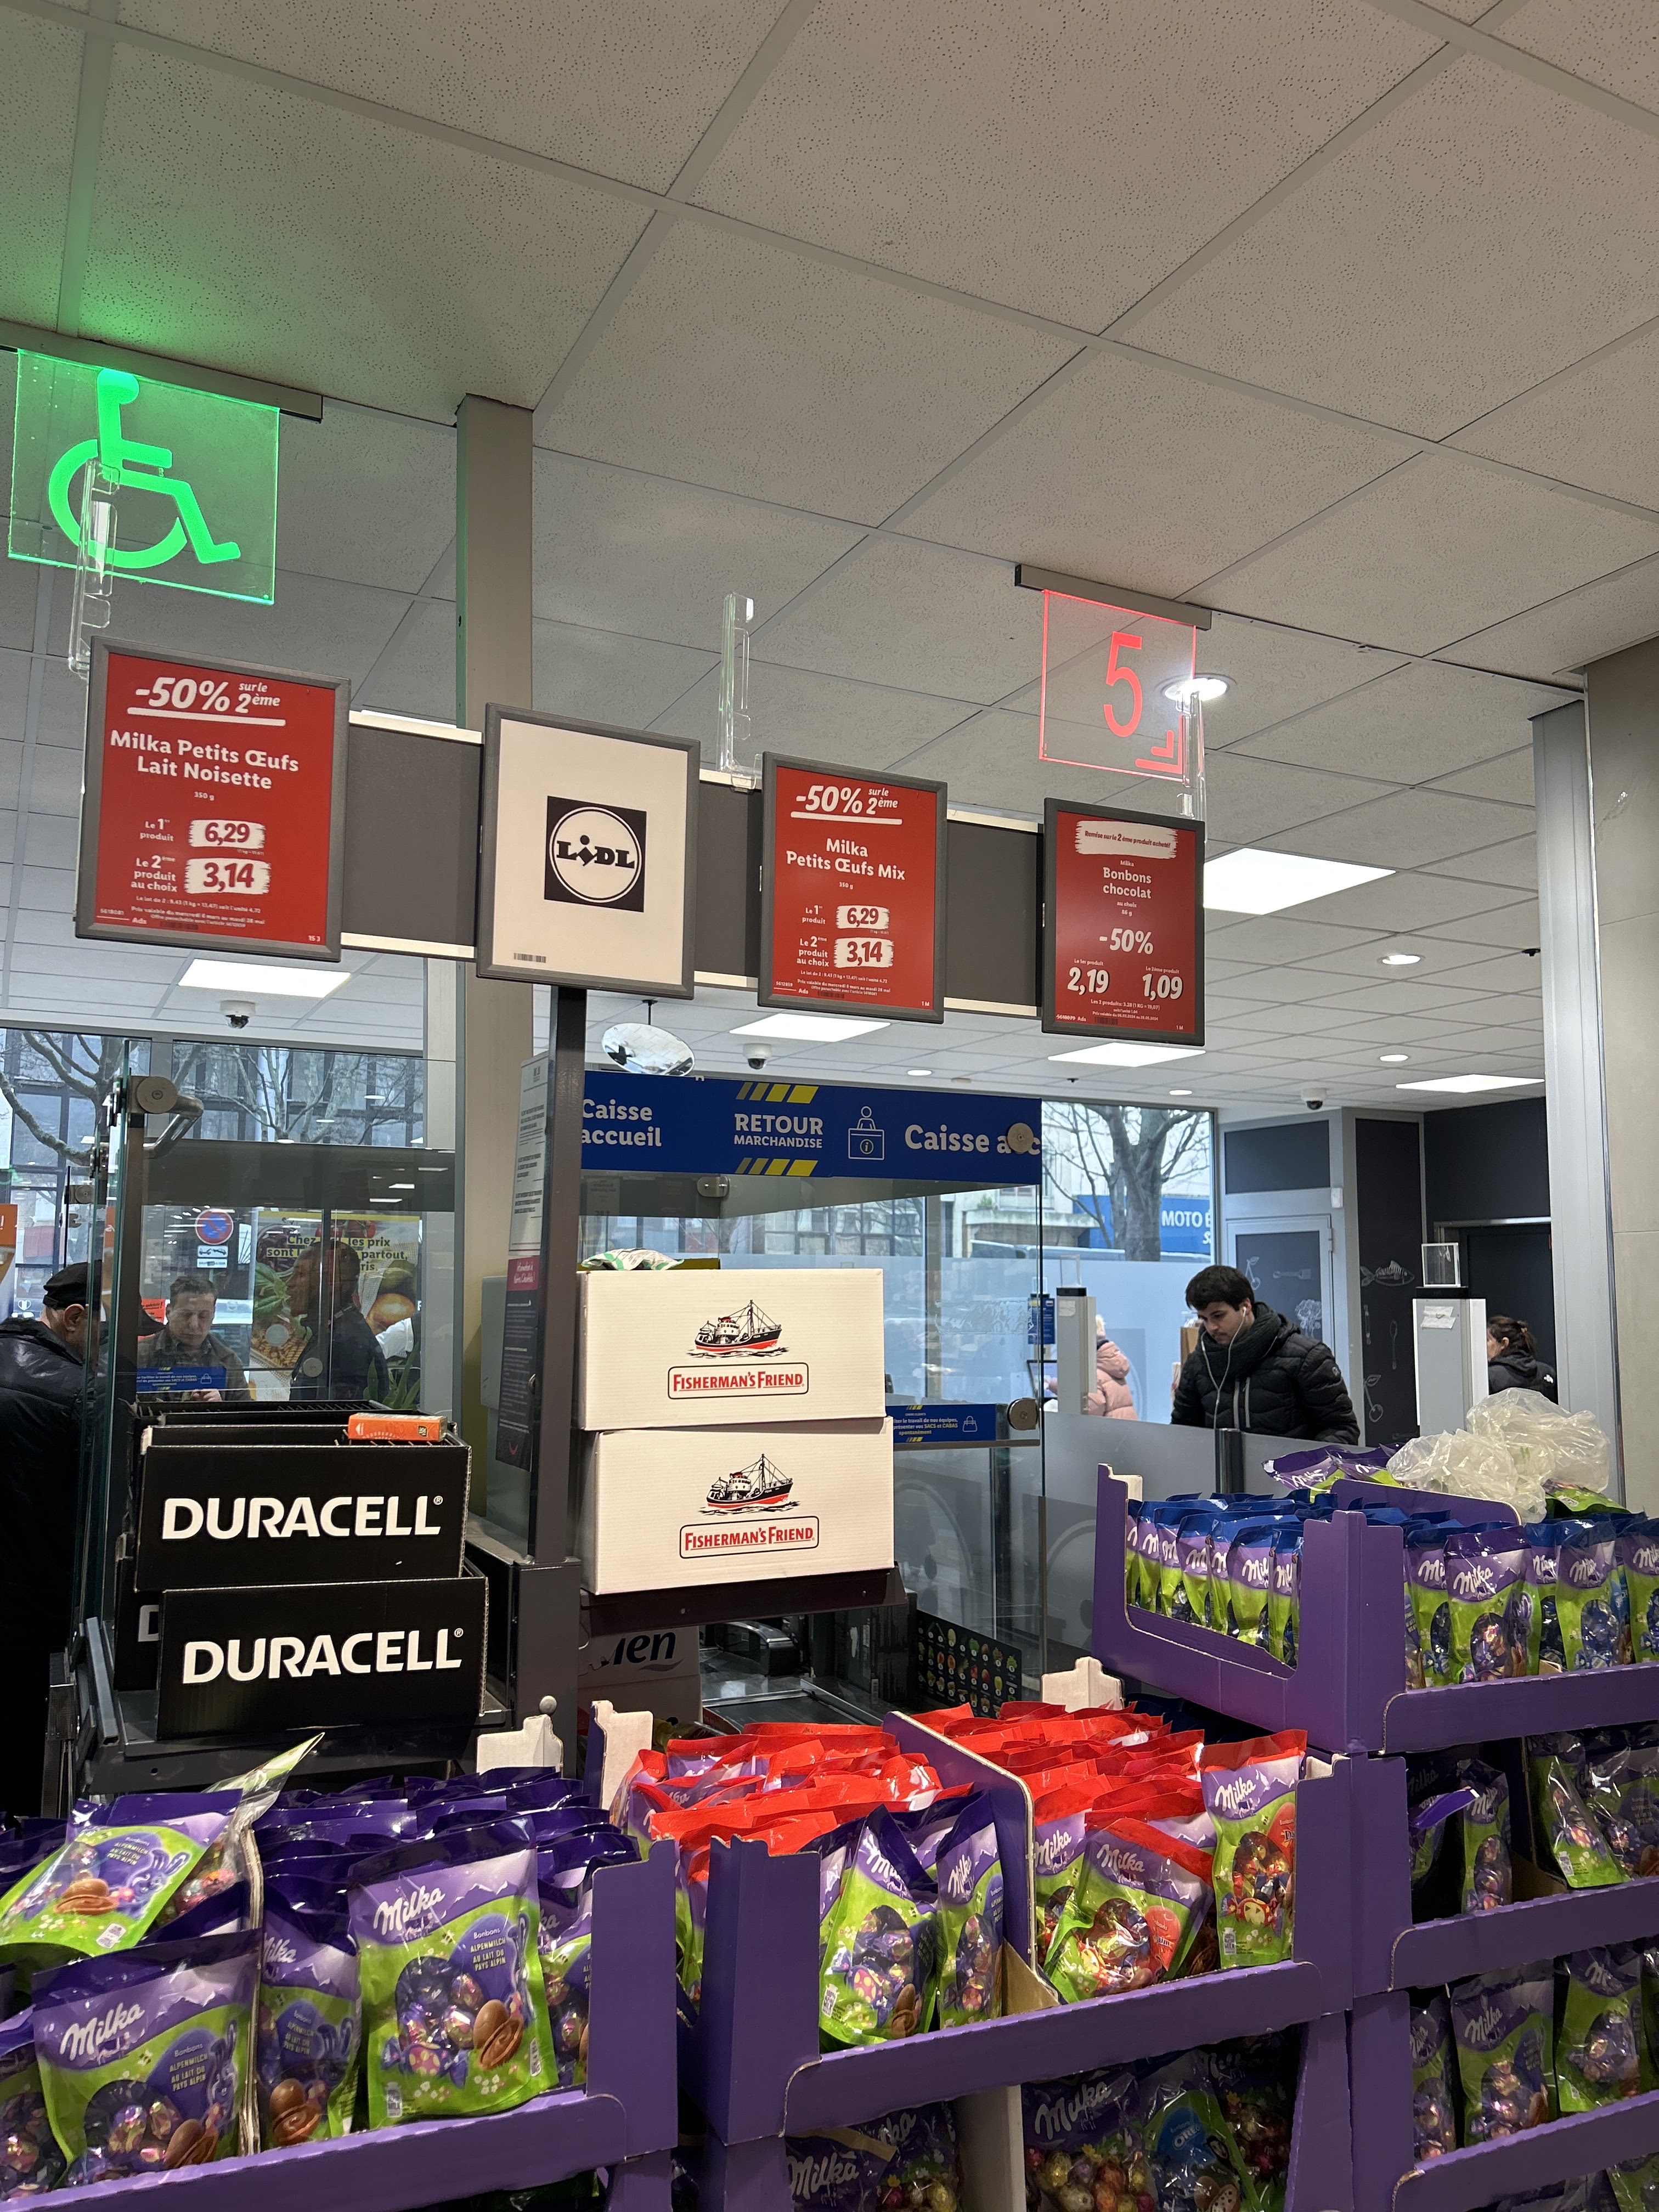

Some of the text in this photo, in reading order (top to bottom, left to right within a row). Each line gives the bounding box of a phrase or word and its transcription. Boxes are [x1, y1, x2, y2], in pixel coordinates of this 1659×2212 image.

[135, 677, 230, 712] -50%
[238, 681, 267, 693] sur le
[1104, 631, 1142, 737] 5
[235, 693, 280, 714] 2ème
[110, 730, 299, 771] Milka Petits Œufs
[137, 756, 272, 789] Lait Noisette
[796, 785, 864, 814] -50%
[868, 787, 889, 797] sur le
[866, 797, 898, 815] 2ème
[145, 821, 156, 829] Le
[205, 823, 250, 845] 6,29
[140, 832, 174, 842] produit
[1085, 831, 1103, 839] Remise
[1117, 833, 1122, 842] 2
[826, 838, 868, 857] Milka
[136, 857, 149, 867] Le
[786, 850, 905, 881] Petits Œufs Mix
[134, 871, 176, 882] produit
[204, 863, 254, 891] 3,14
[1103, 867, 1152, 883] Bonbons
[131, 882, 177, 892] au choix
[1103, 883, 1152, 899] chocolat
[802, 916, 826, 924] produit
[847, 907, 879, 927] 6,29
[1099, 928, 1154, 955] -50%
[799, 949, 828, 958] produit
[808, 958, 830, 967] choix
[847, 941, 883, 966] 3,14
[1067, 967, 1109, 995] 2,19
[1142, 974, 1183, 1001] 1,09
[583, 1099, 652, 1121] Caisse
[735, 1113, 823, 1135] RETOUR
[582, 1126, 662, 1147] accueil
[733, 1134, 823, 1149] MARCHANDISE
[905, 1124, 990, 1153] Caisse
[1162, 1210, 1203, 1228] MOTO
[287, 1235, 391, 1248] Chez les prix
[267, 1247, 408, 1261] sont partout,
[673, 1370, 803, 1391] FISHERMAN'S FRIEND
[685, 1526, 813, 1550] FISHERMAN'S FRIEND
[1453, 1566, 1494, 1594] Milka
[1215, 1777, 1256, 1811] Milka
[114, 1842, 149, 1855] ALPENMILCH
[1097, 1844, 1144, 1874] Milka
[374, 1886, 445, 1936] Milka
[474, 1927, 501, 1939] Bonbons
[470, 1937, 507, 1953] ALPENMILCH
[473, 1949, 504, 1963] AU LAIT DU
[475, 1957, 507, 1972] PAYS ALPIN
[60, 2003, 145, 2061] Milka
[1465, 2007, 1503, 2044] Milka
[170, 2052, 208, 2073] ALPENMILCH
[171, 2074, 179, 2084] AU
[182, 2069, 194, 2080] LAIT
[190, 2074, 206, 2086] ALPIN
[1034, 2081, 1111, 2140] Milka
[786, 2152, 859, 2200] Milka
